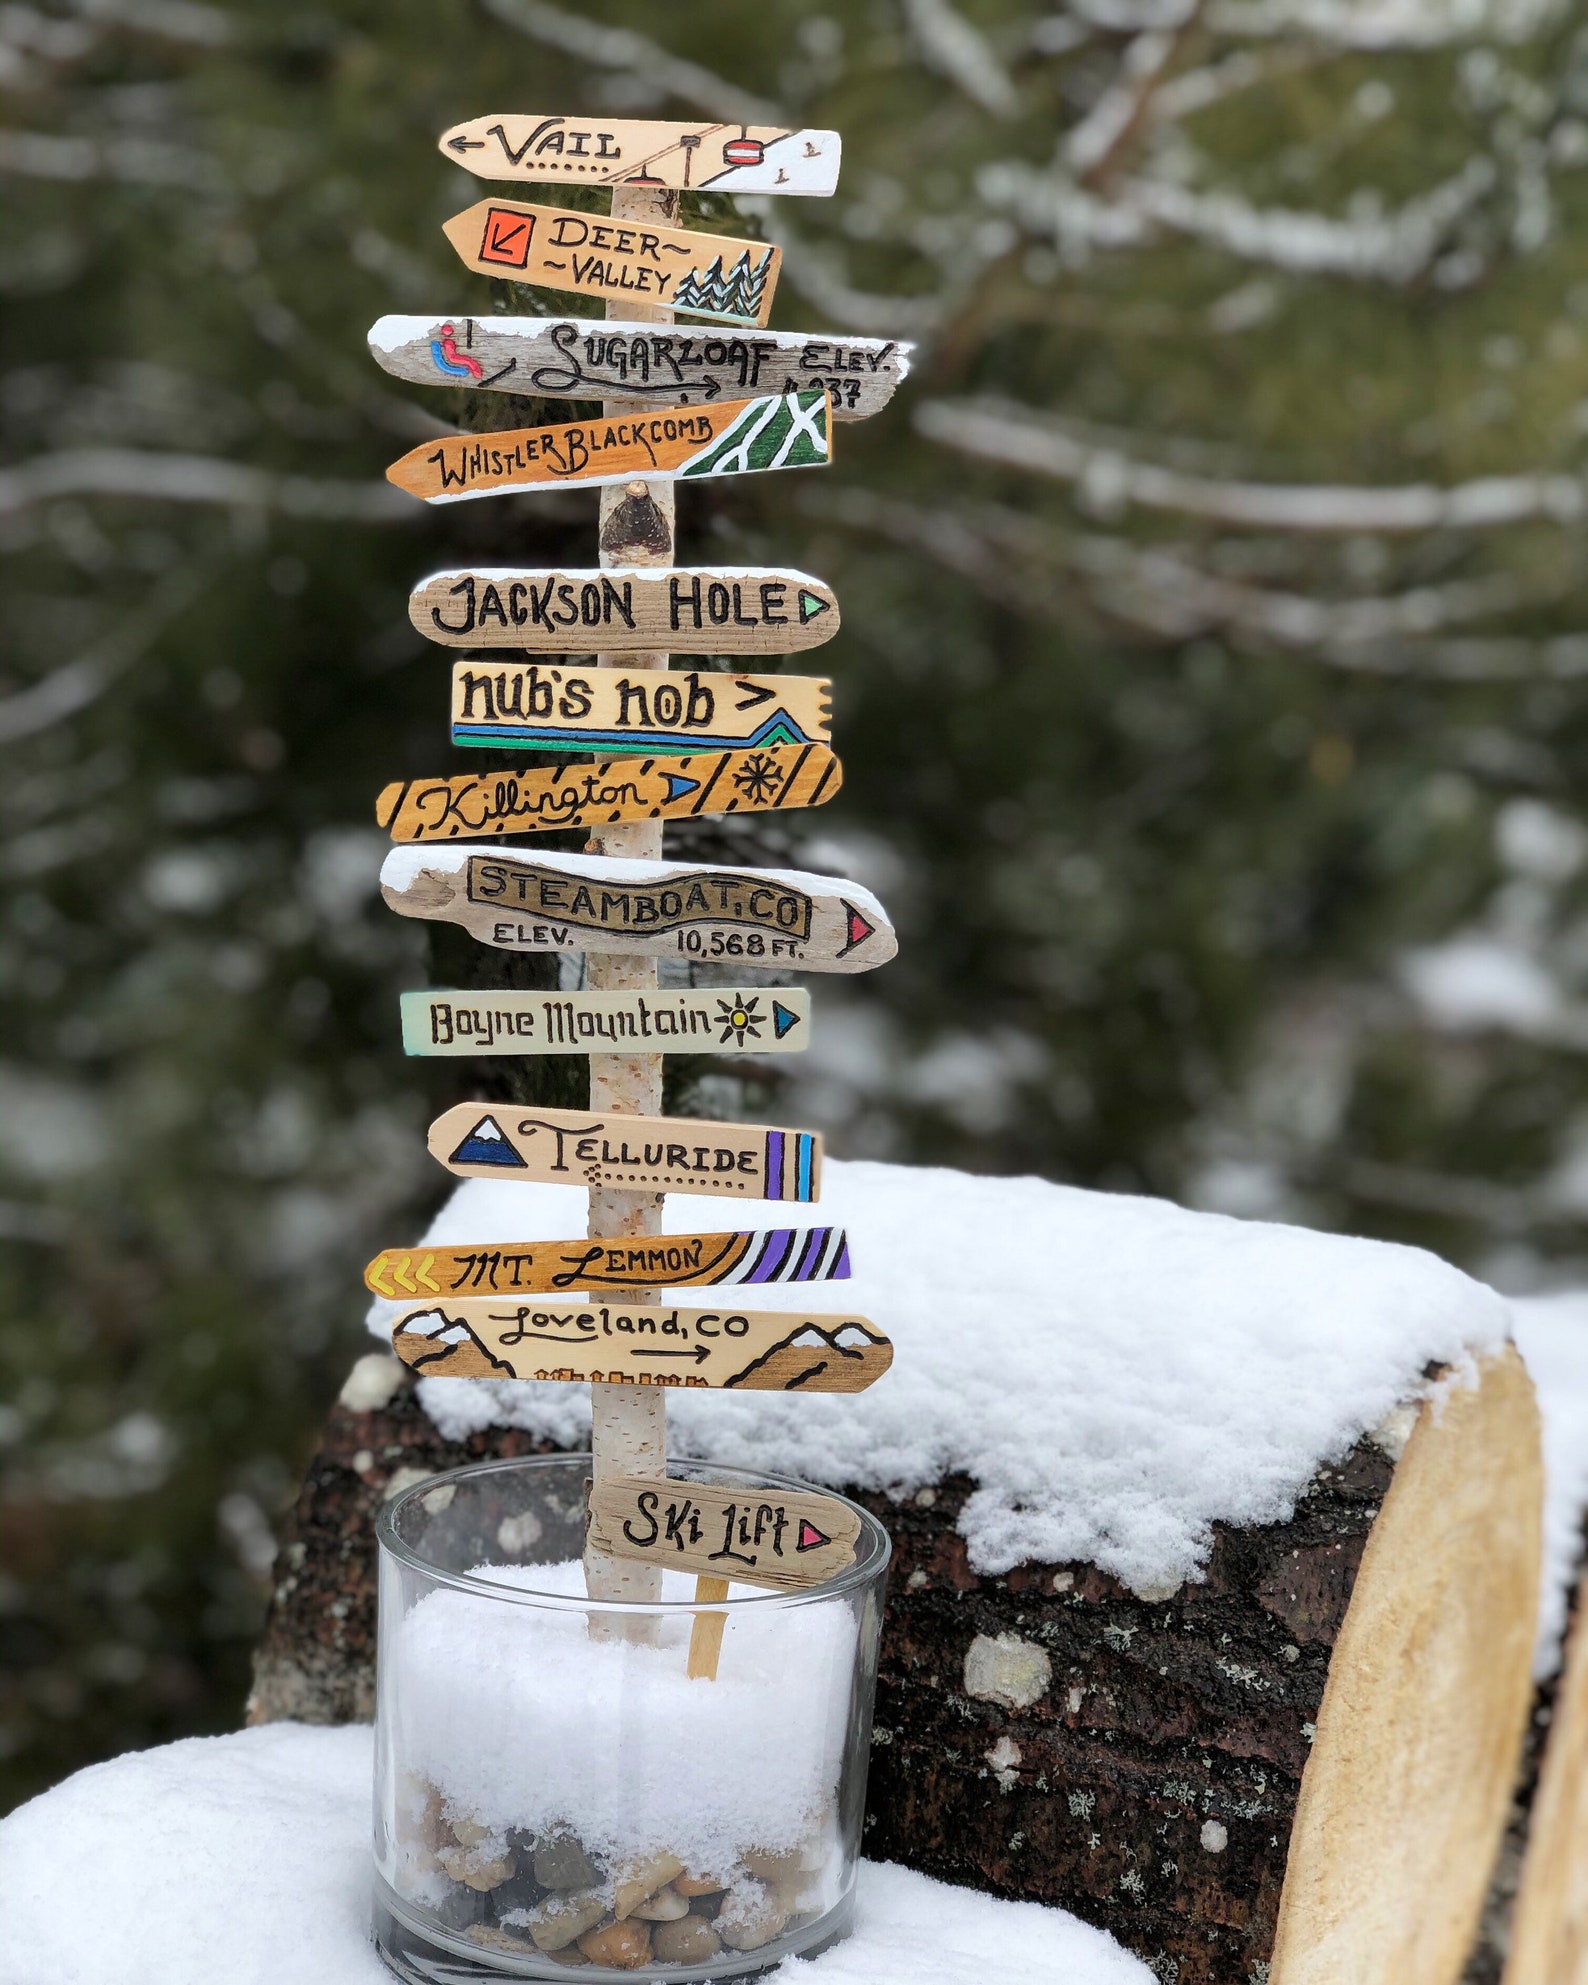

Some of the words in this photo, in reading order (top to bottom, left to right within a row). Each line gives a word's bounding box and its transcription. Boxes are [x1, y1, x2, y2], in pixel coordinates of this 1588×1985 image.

[486, 118, 621, 165] VAIL
[548, 217, 661, 262] DEER
[572, 253, 673, 295] VALLEY
[531, 324, 777, 391] SUGARLOAF
[800, 342, 895, 373] ELEV.
[428, 434, 567, 488] WHISTLER
[547, 416, 714, 475] BLACKCOMB
[431, 577, 637, 635] JACKSON
[669, 577, 789, 630] HOLE
[459, 666, 595, 720] nub's
[615, 673, 716, 728] nob
[416, 774, 648, 831] Killington
[492, 923, 574, 947] ELEV.
[677, 929, 765, 959] 10,568
[771, 940, 805, 958] FT.
[430, 1003, 534, 1046] Boyne
[542, 998, 711, 1045] Mountain
[518, 1120, 759, 1174] TELLURIDE
[450, 1252, 532, 1289] MT.
[552, 1239, 703, 1286] LEMMON
[489, 1306, 690, 1344] Loveland,
[695, 1315, 749, 1337] CO
[708, 1504, 789, 1566] Lift
